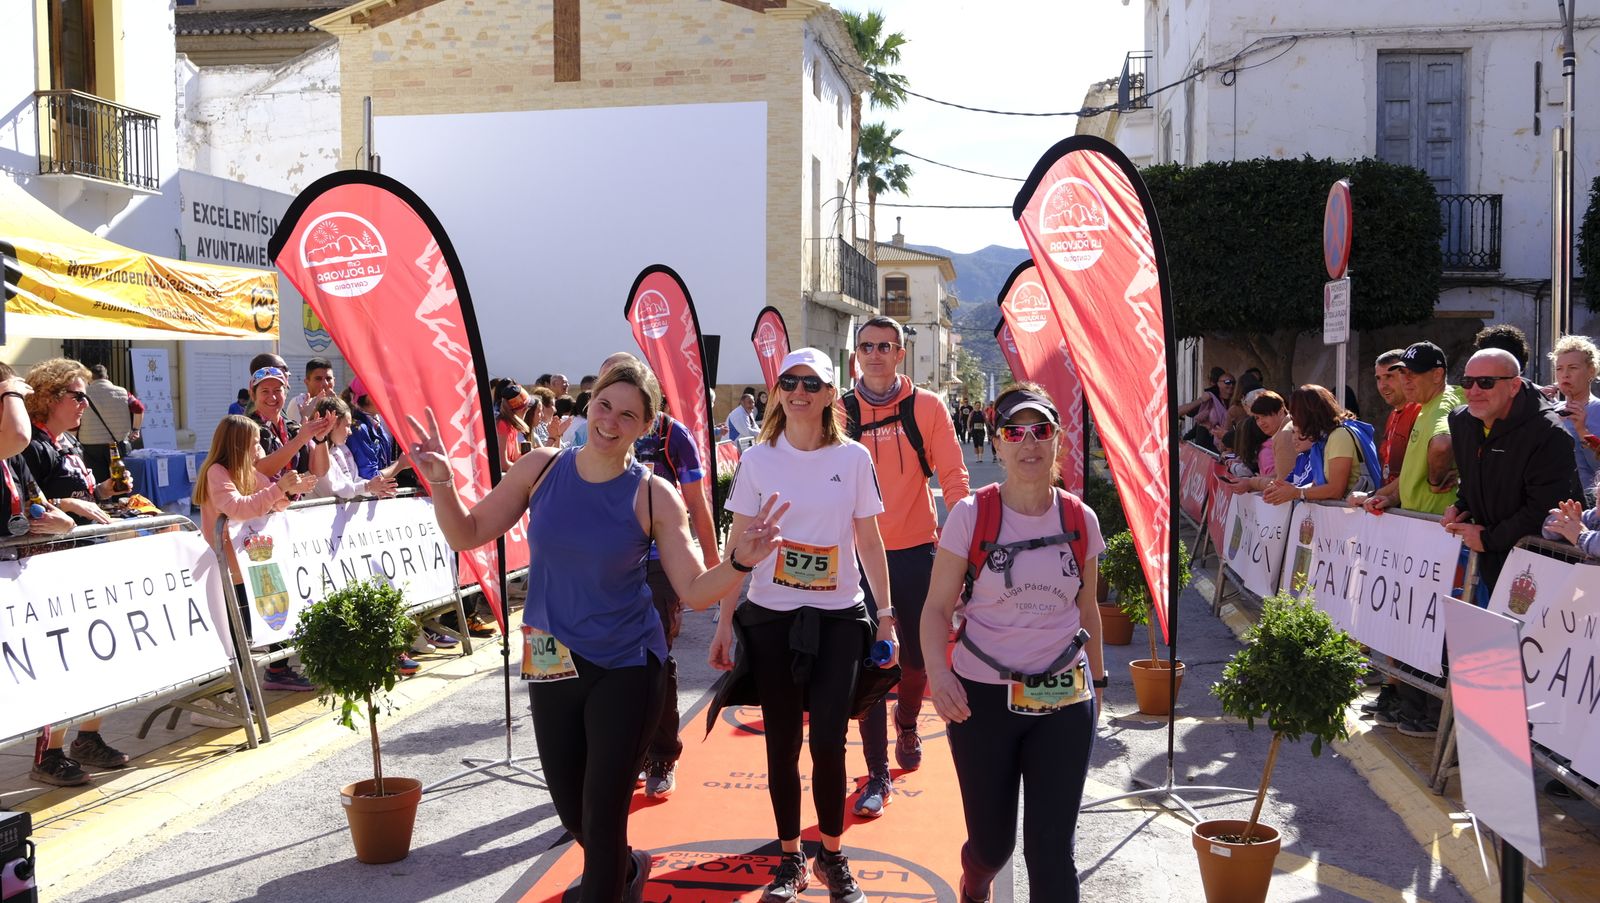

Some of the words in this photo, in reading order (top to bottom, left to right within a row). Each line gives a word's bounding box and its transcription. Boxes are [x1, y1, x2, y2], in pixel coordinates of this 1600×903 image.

[418, 521, 437, 537] DE
[295, 541, 446, 600] CANTORIA
[785, 550, 829, 572] 575
[1418, 559, 1441, 582] DE
[6, 576, 154, 627] TAMIENTO
[164, 568, 193, 592] DE
[1003, 586, 1023, 599] Liga
[1, 597, 210, 685] NTORIA
[531, 636, 557, 656] 604
